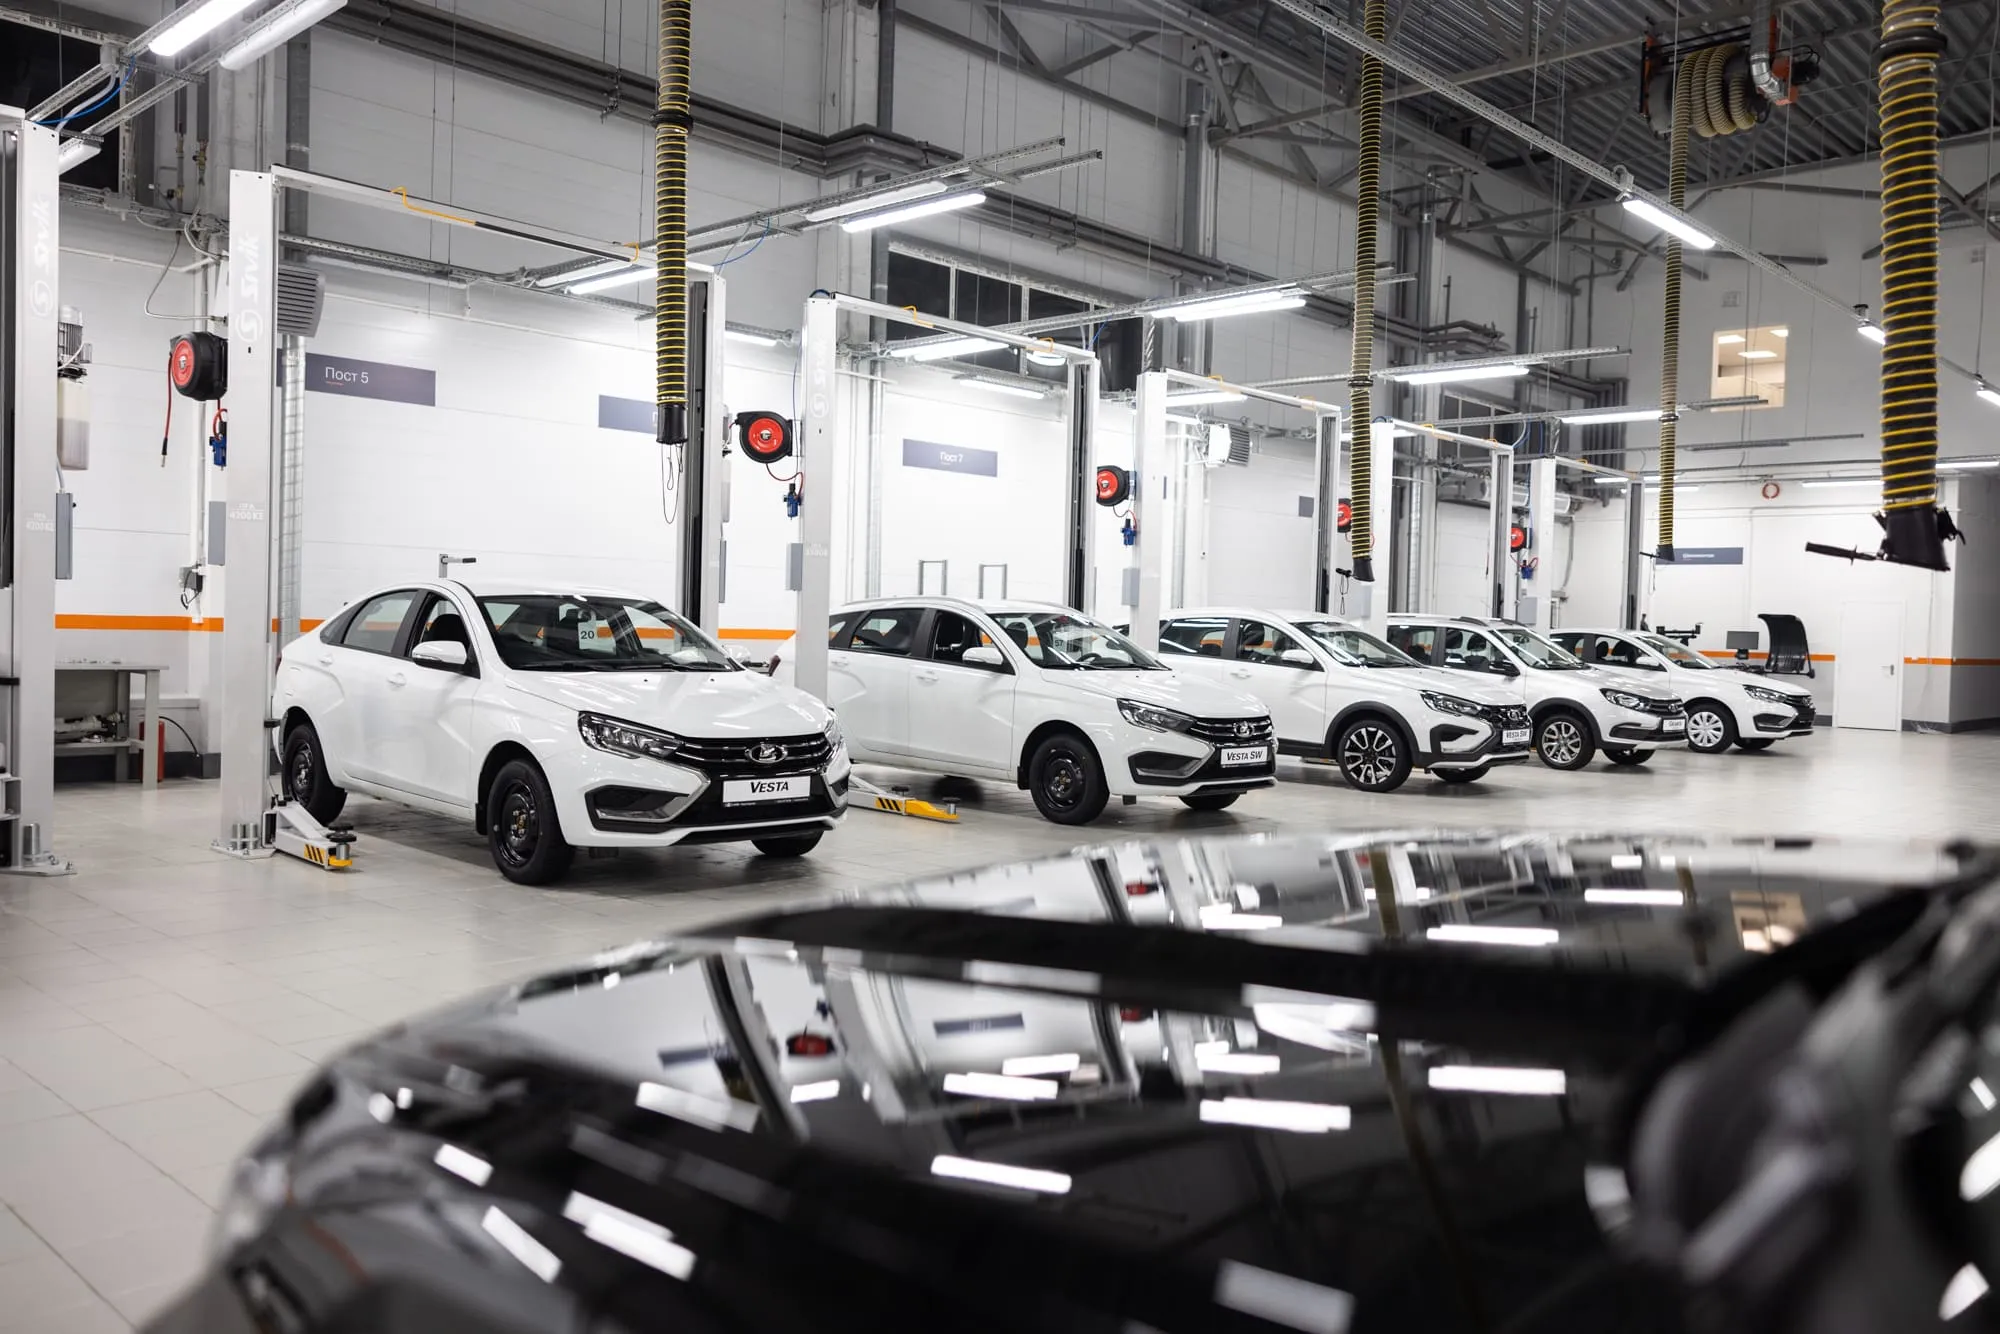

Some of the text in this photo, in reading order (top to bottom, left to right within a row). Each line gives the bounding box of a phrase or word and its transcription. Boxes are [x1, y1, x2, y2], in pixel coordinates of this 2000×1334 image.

[325, 366, 358, 382] Пост
[361, 372, 369, 384] 5
[940, 451, 964, 463] Пост 7
[580, 630, 595, 640] 20
[1055, 639, 1063, 647] 57
[1227, 750, 1264, 761] VESTA SW
[750, 781, 789, 794] VESTA
